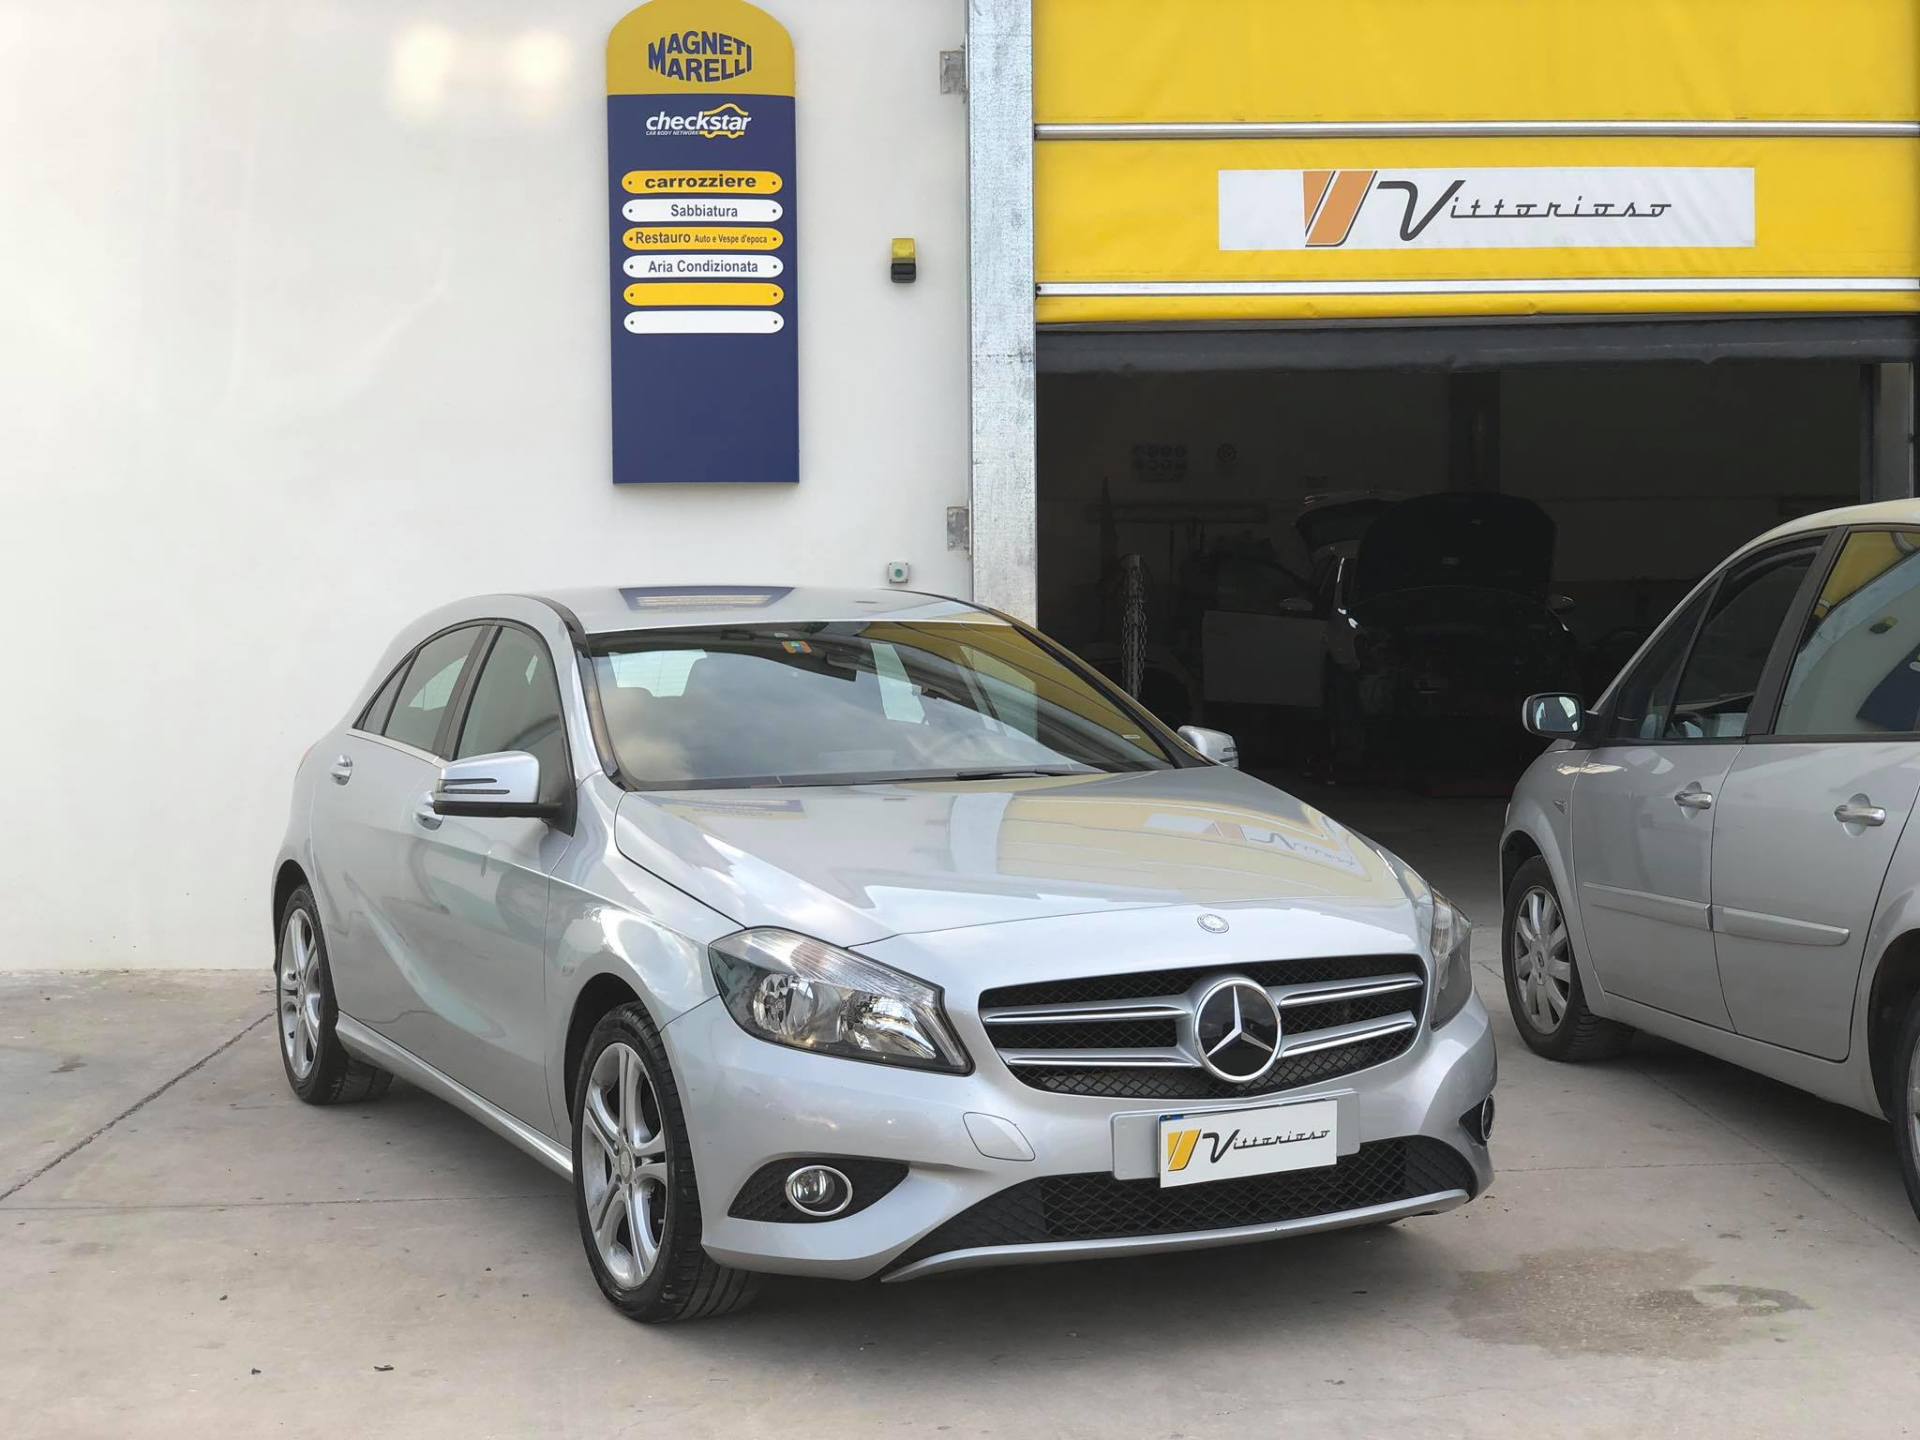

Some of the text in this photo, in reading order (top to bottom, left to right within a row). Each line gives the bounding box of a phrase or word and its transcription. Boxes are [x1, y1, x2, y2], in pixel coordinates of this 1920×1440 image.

[648, 31, 752, 65] MAGNETI
[648, 48, 752, 82] MARELLI
[646, 111, 752, 131] checkstar
[645, 174, 757, 189] carrozziere
[670, 204, 738, 218] Sabbiatura
[1376, 180, 1672, 242] Vittorioso
[635, 231, 691, 244] Restauro
[694, 234, 711, 243] Auto
[718, 234, 740, 245] Vespe
[740, 234, 768, 245] d'epoca
[648, 260, 758, 273] Aria Condizionata
[1202, 1129, 1331, 1164] Vittorioso
